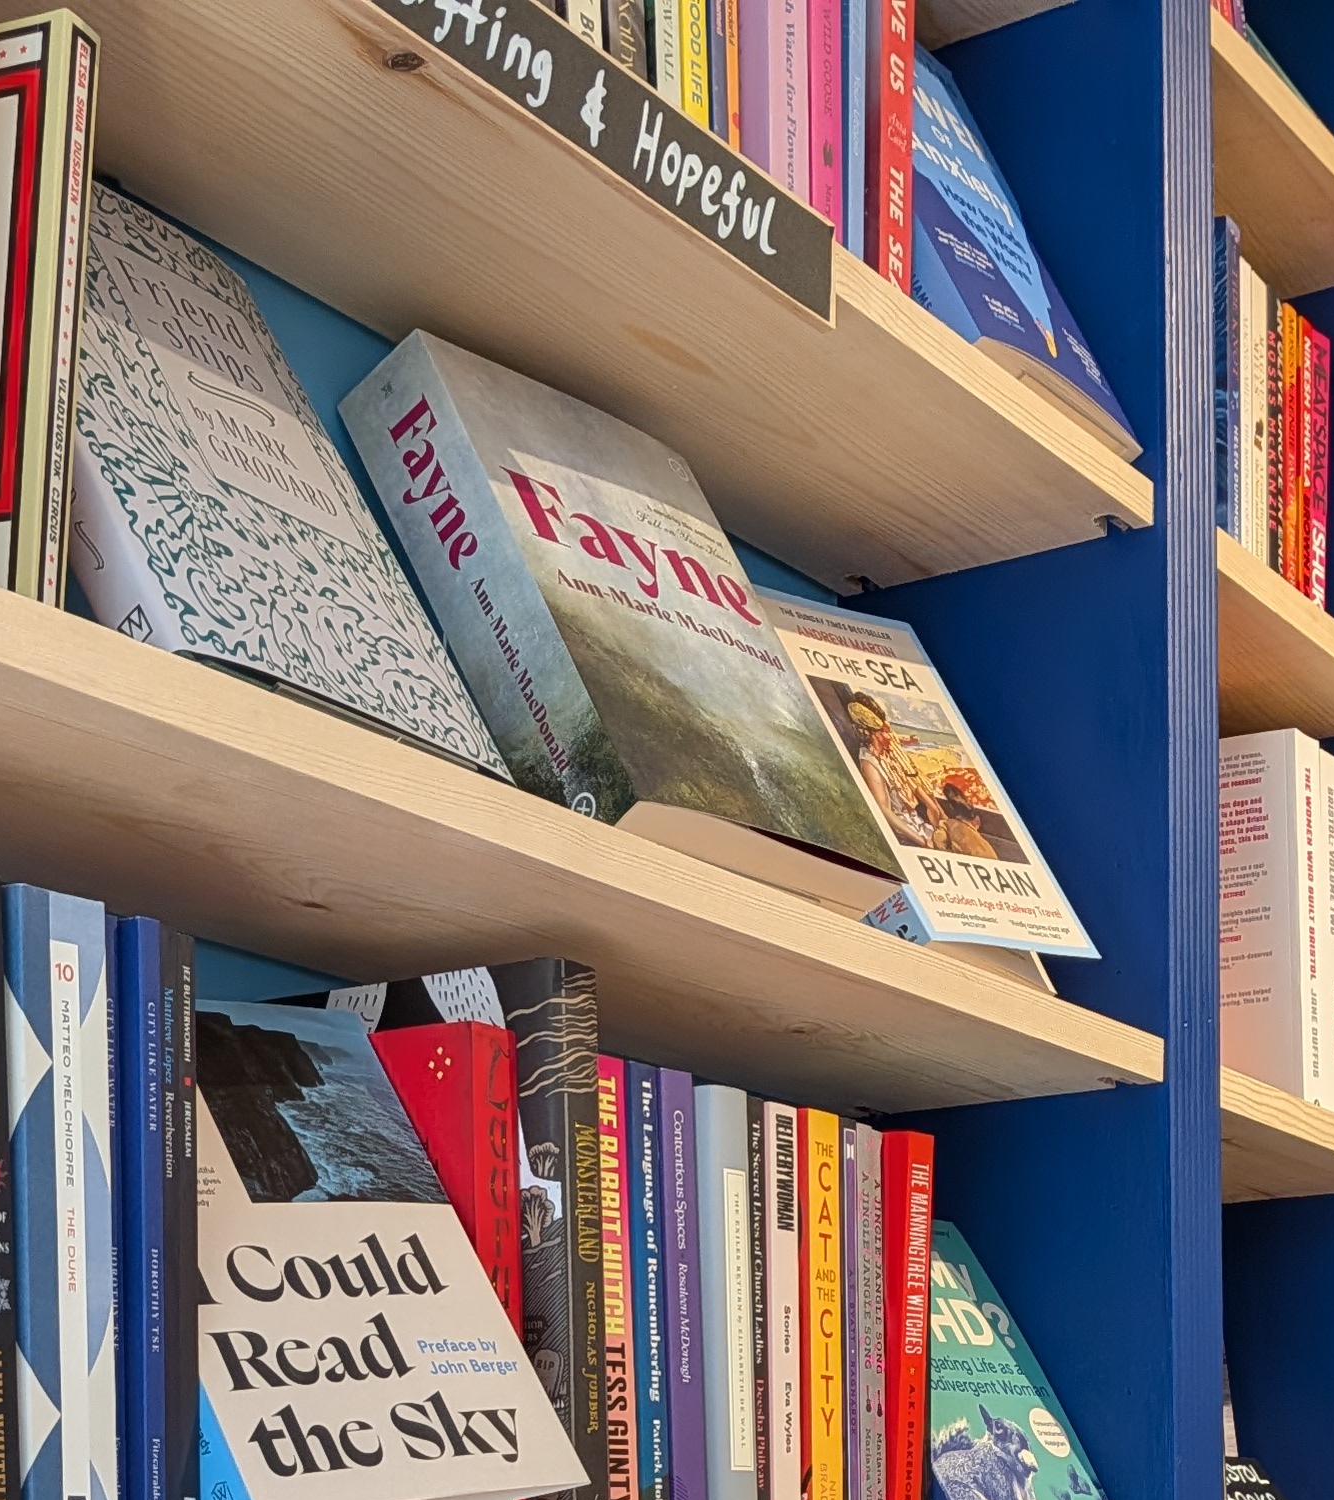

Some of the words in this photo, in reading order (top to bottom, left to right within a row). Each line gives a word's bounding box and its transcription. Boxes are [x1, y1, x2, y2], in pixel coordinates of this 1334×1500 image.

[580, 69, 607, 147] &
[633, 98, 778, 256] Hopeful
[192, 406, 215, 431] by
[216, 409, 291, 468] MARK
[206, 433, 338, 518] GIROUARD
[386, 391, 481, 572] Fayne
[500, 464, 762, 628] Fayne
[555, 566, 677, 628] Ann-Marie
[677, 613, 786, 675] MacDonald
[798, 646, 828, 673] TO
[830, 652, 866, 680] THE
[863, 657, 925, 694] SEA
[916, 855, 957, 887] BY
[957, 861, 1041, 900] TRAIN
[774, 1112, 796, 1233] DELIVERYWOMAN
[225, 1231, 451, 1305] Could
[205, 1311, 418, 1392] Read
[417, 1337, 476, 1356] Preface
[478, 1337, 498, 1357] by
[429, 1357, 466, 1377] John
[467, 1357, 519, 1379] Berger
[247, 1402, 386, 1479] the
[388, 1389, 519, 1464] Sky
